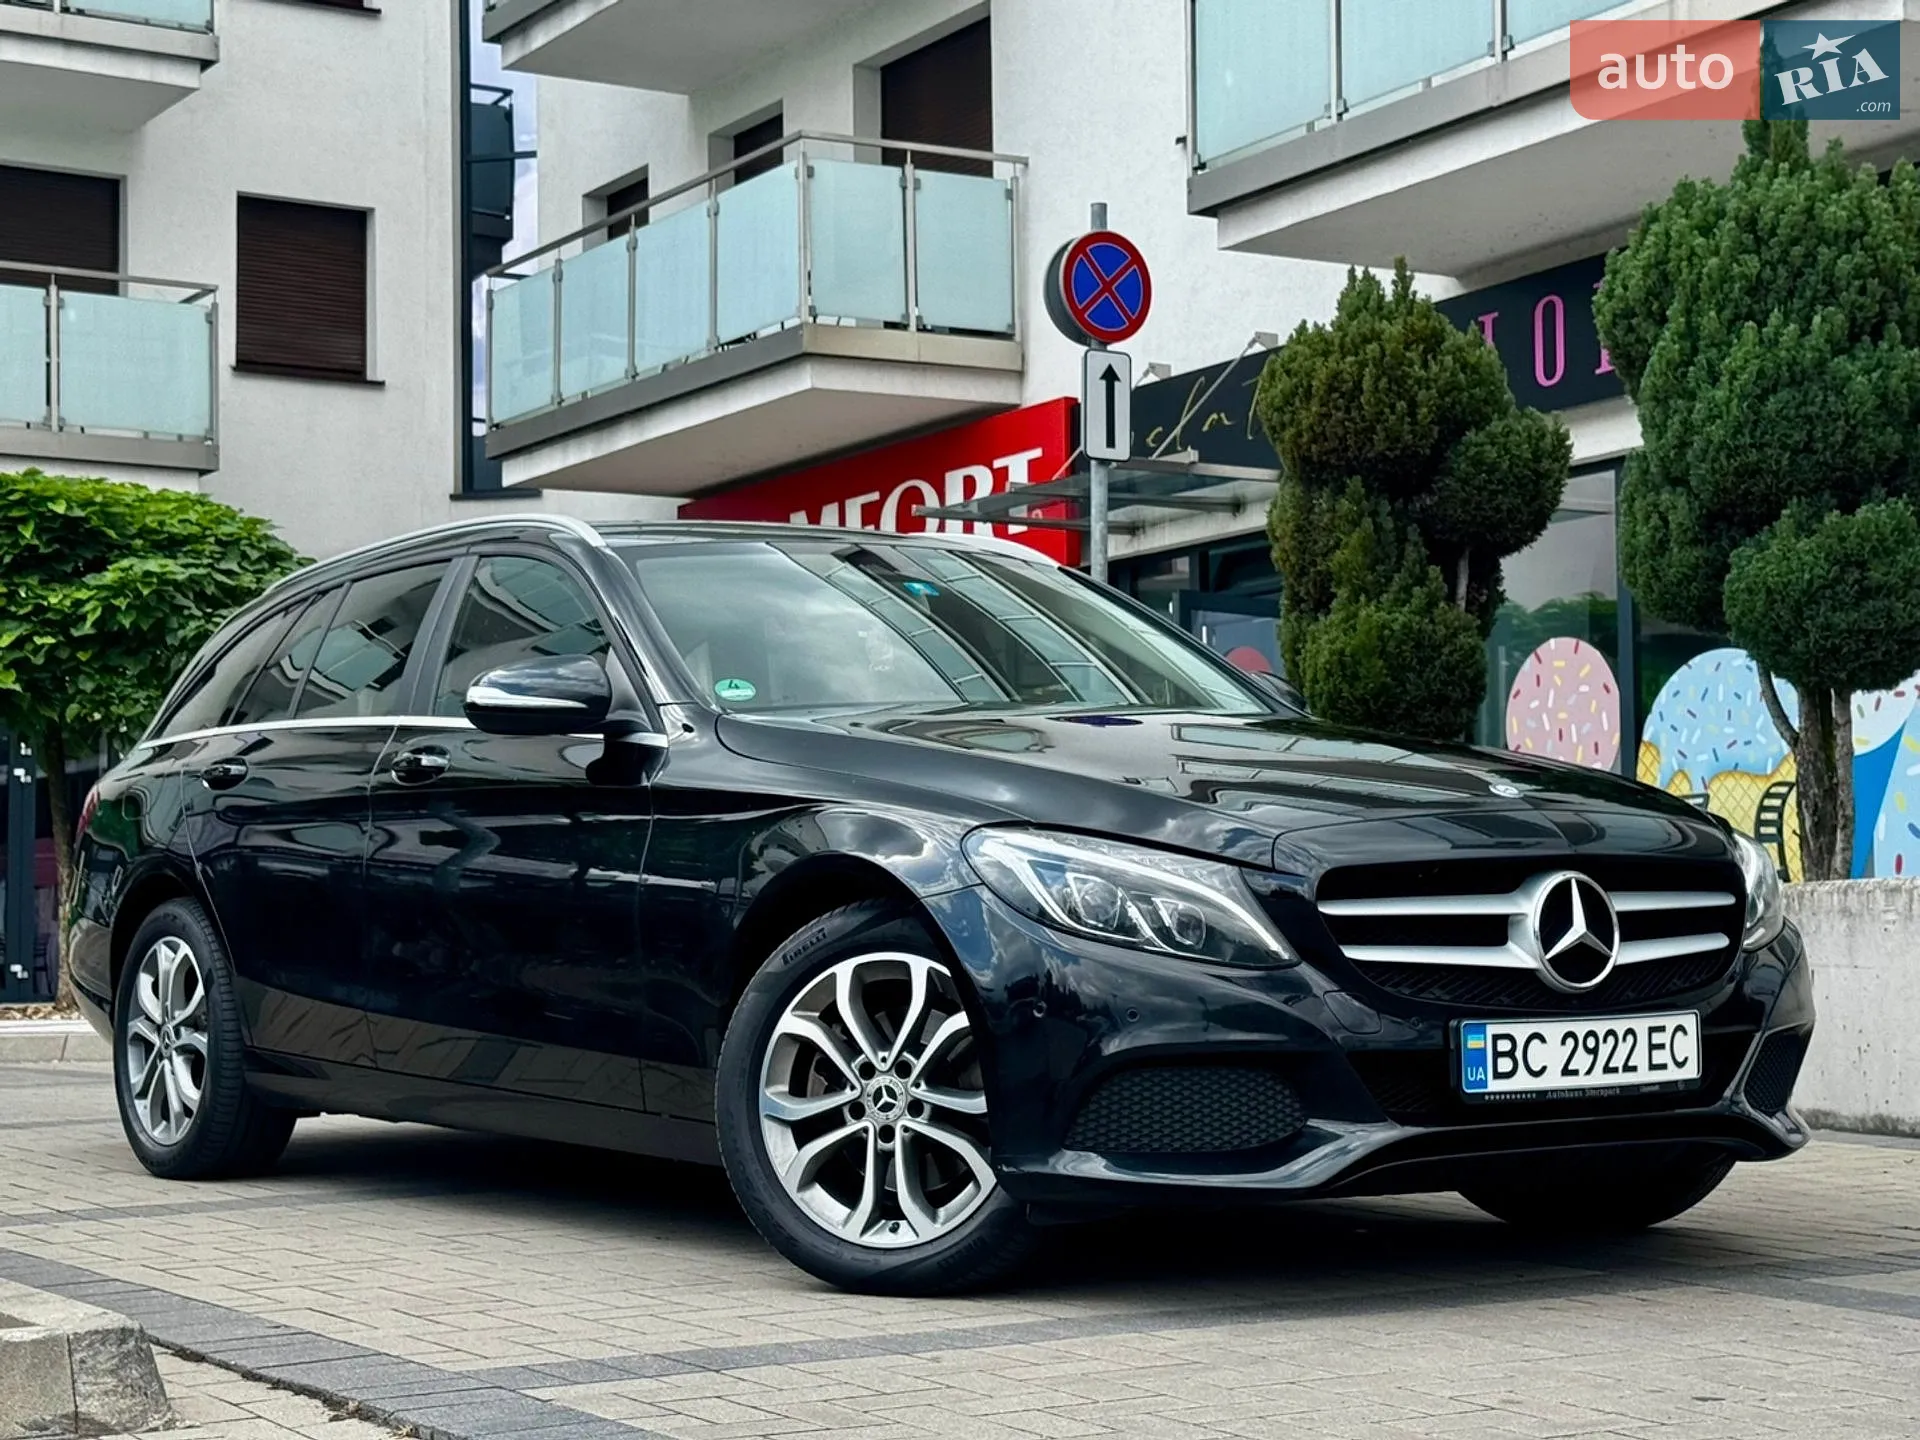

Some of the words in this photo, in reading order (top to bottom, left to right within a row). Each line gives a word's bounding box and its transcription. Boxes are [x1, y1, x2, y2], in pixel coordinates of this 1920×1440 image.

[781, 926, 828, 966] PIRELLI
[1491, 1031, 1549, 1081] BC
[1560, 1027, 1639, 1077] 2922
[1648, 1023, 1689, 1072] EC
[1467, 1067, 1486, 1082] UA
